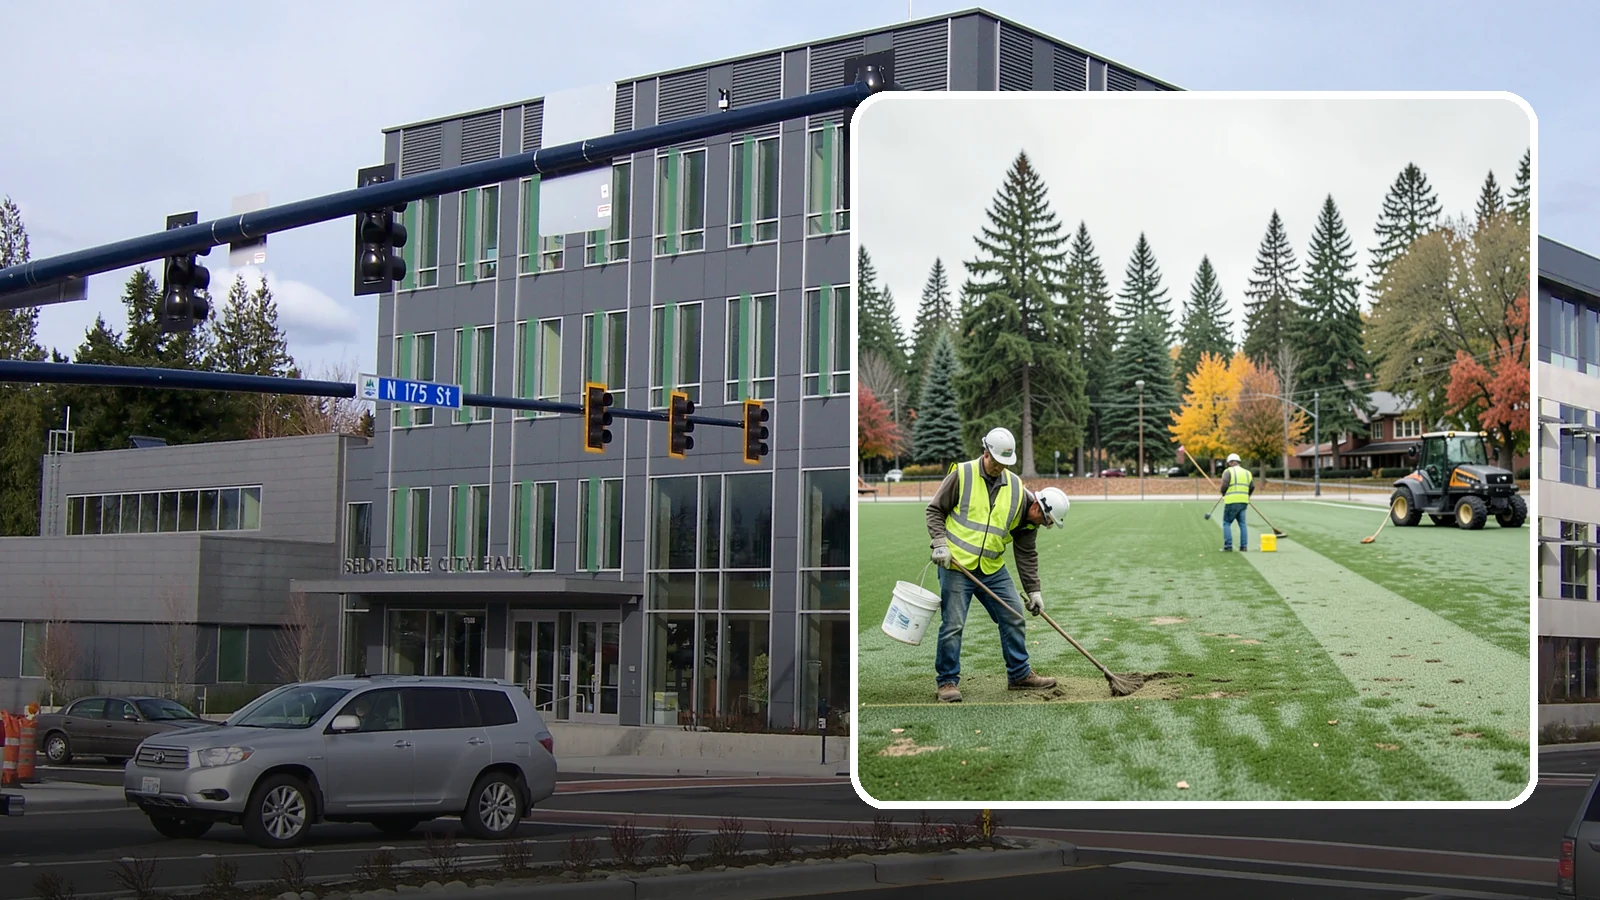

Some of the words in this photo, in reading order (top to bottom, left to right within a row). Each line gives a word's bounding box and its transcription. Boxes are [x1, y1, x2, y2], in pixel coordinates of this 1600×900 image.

[387, 380, 396, 399] N
[405, 383, 427, 403] 175
[436, 386, 451, 406] St
[344, 557, 432, 574] SHORELINE
[438, 556, 475, 572] CITY
[483, 555, 525, 571] HALL
